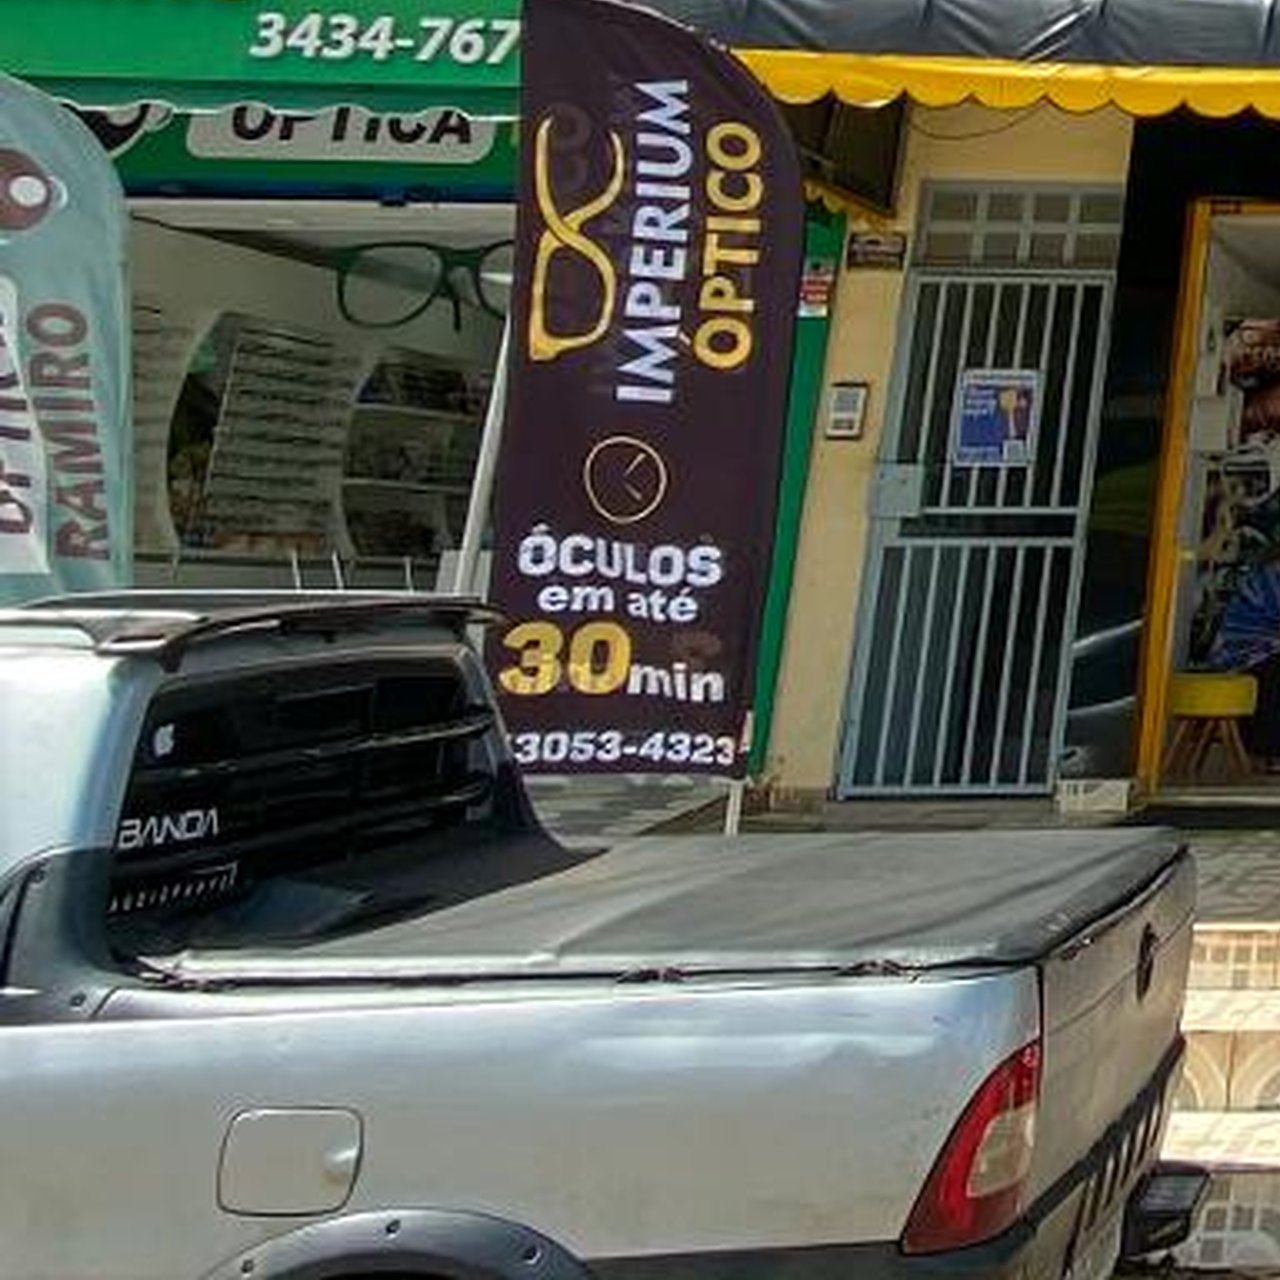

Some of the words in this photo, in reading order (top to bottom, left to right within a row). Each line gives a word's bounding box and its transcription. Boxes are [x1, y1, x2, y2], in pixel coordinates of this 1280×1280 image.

[616, 79, 693, 402] IMPERIUM
[676, 121, 763, 370] ÓPTICO
[26, 303, 110, 560] RAMIRO
[538, 585, 614, 612] em
[627, 588, 699, 622] até
[514, 731, 735, 765] 3053-4323
